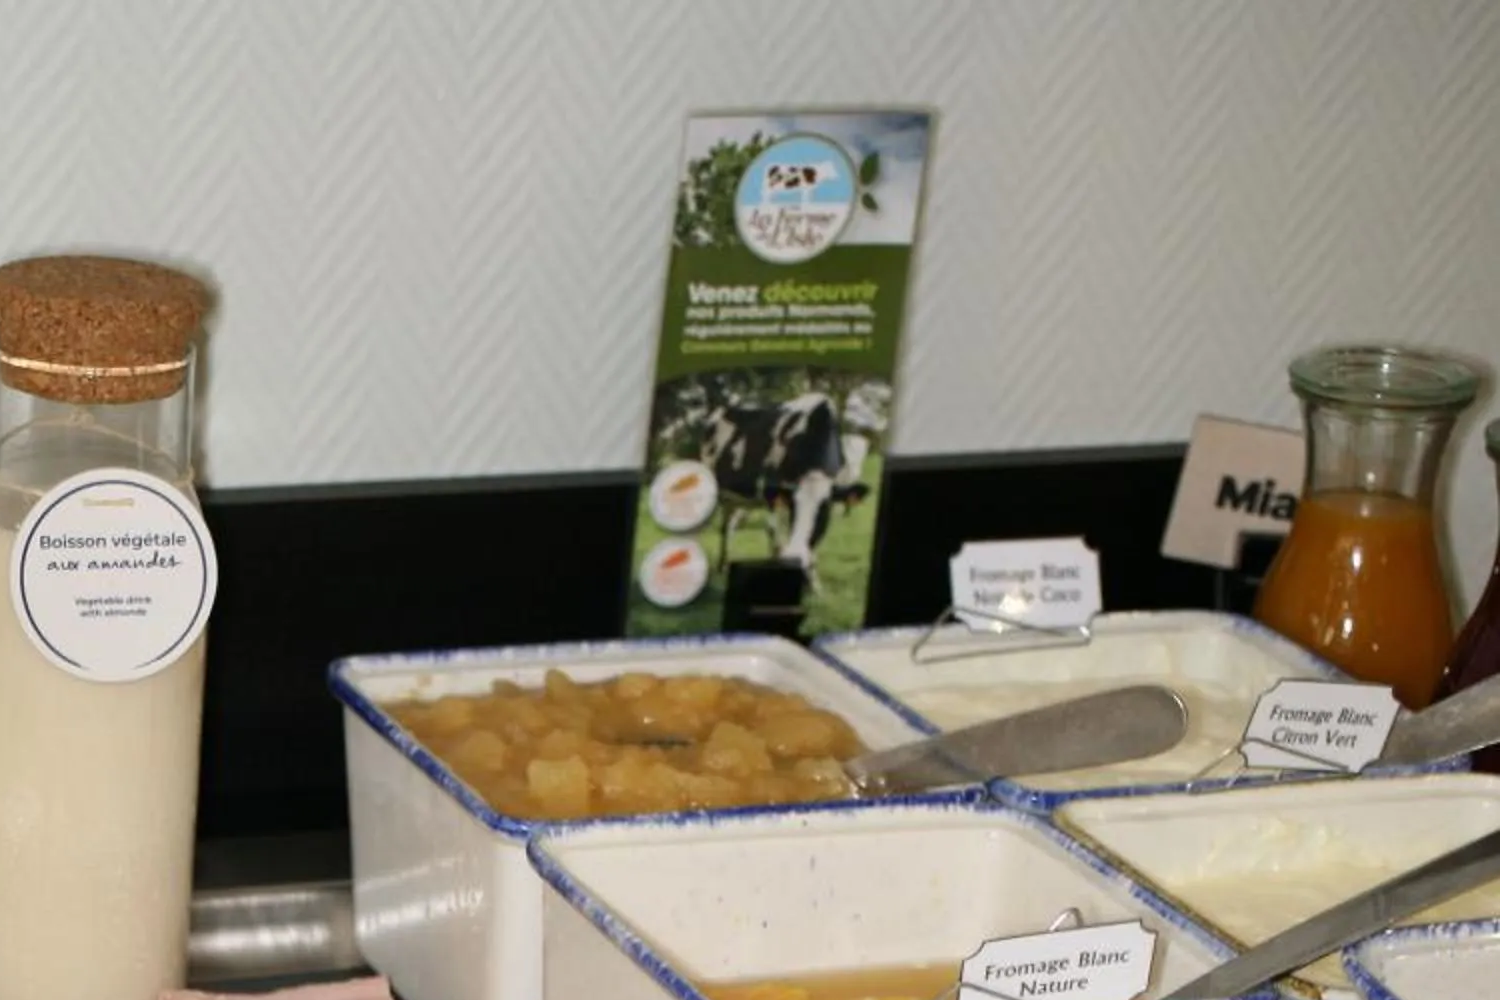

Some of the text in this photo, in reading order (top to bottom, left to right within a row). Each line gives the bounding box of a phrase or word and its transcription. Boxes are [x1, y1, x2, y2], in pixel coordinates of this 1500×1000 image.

[687, 279, 878, 303] Venez découvrir
[39, 532, 186, 551] Boisson végétale
[47, 551, 181, 571] aux amandes
[1269, 704, 1379, 726] Fromage Blanc
[1271, 726, 1359, 748] Citron Vert
[984, 949, 1132, 981] Fromage Blanc
[1018, 977, 1090, 998] Nature
